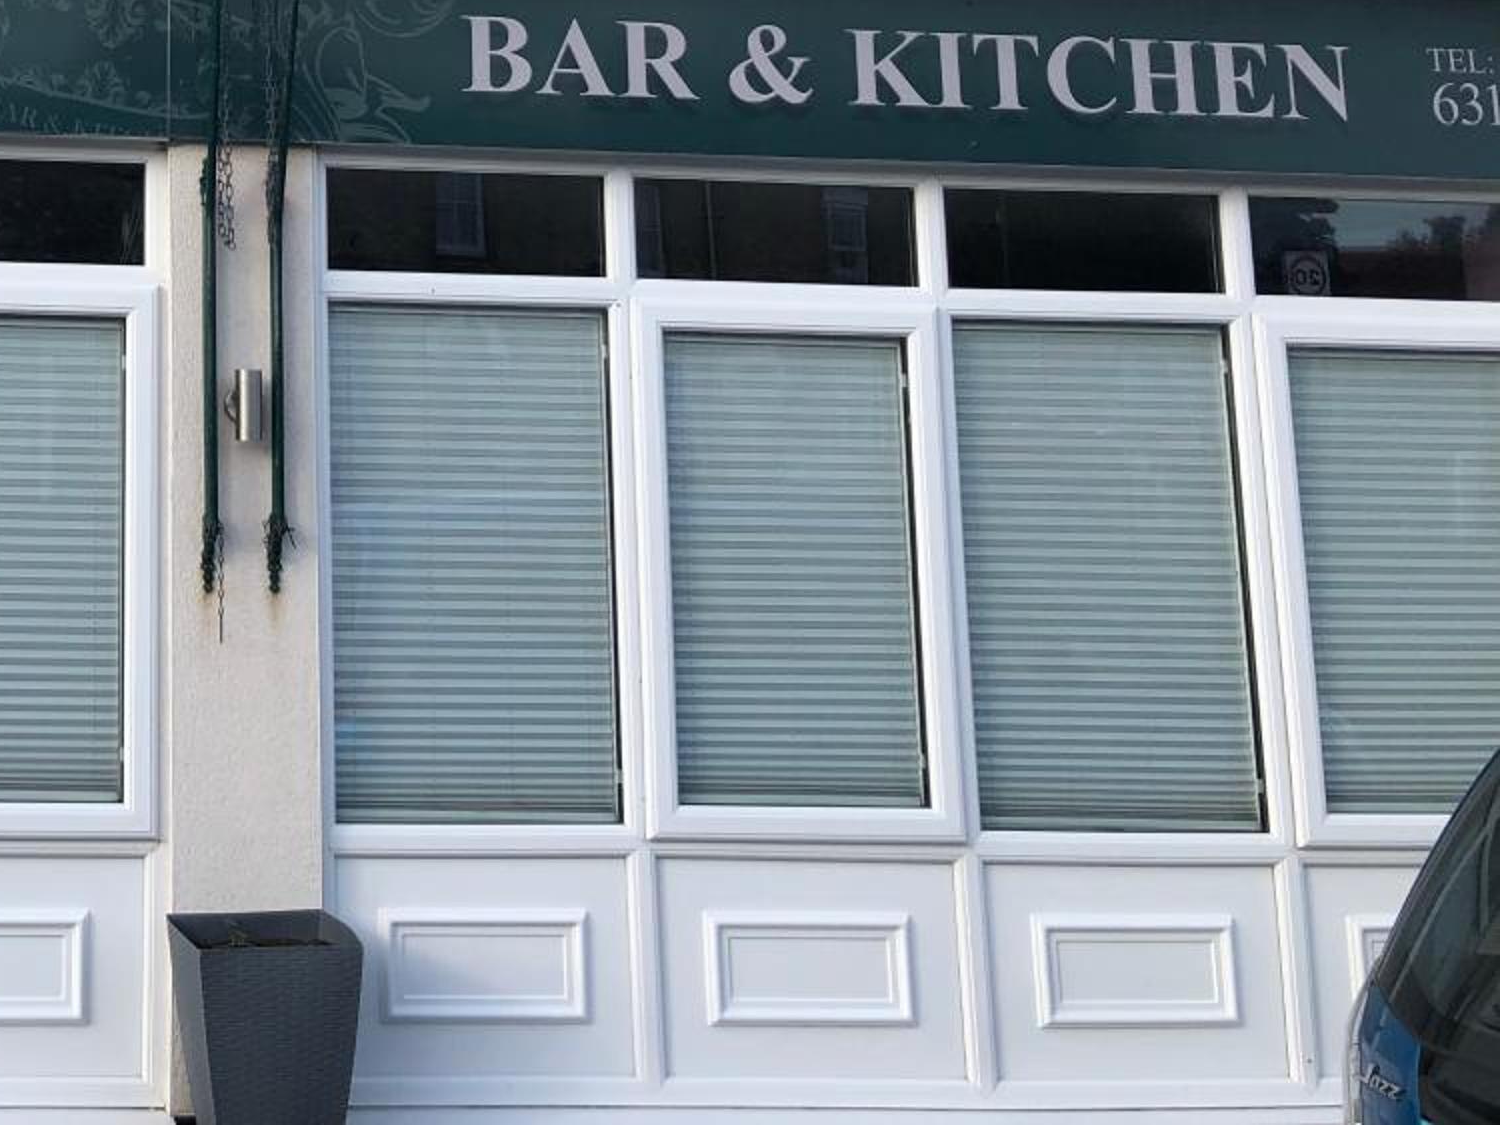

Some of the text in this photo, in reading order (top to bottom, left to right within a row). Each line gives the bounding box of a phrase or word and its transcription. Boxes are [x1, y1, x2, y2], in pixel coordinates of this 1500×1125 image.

[461, 15, 1350, 121] BAR & KITCHEN
[1425, 47, 1494, 75] TEL:
[1353, 1063, 1402, 1100] Jazz
